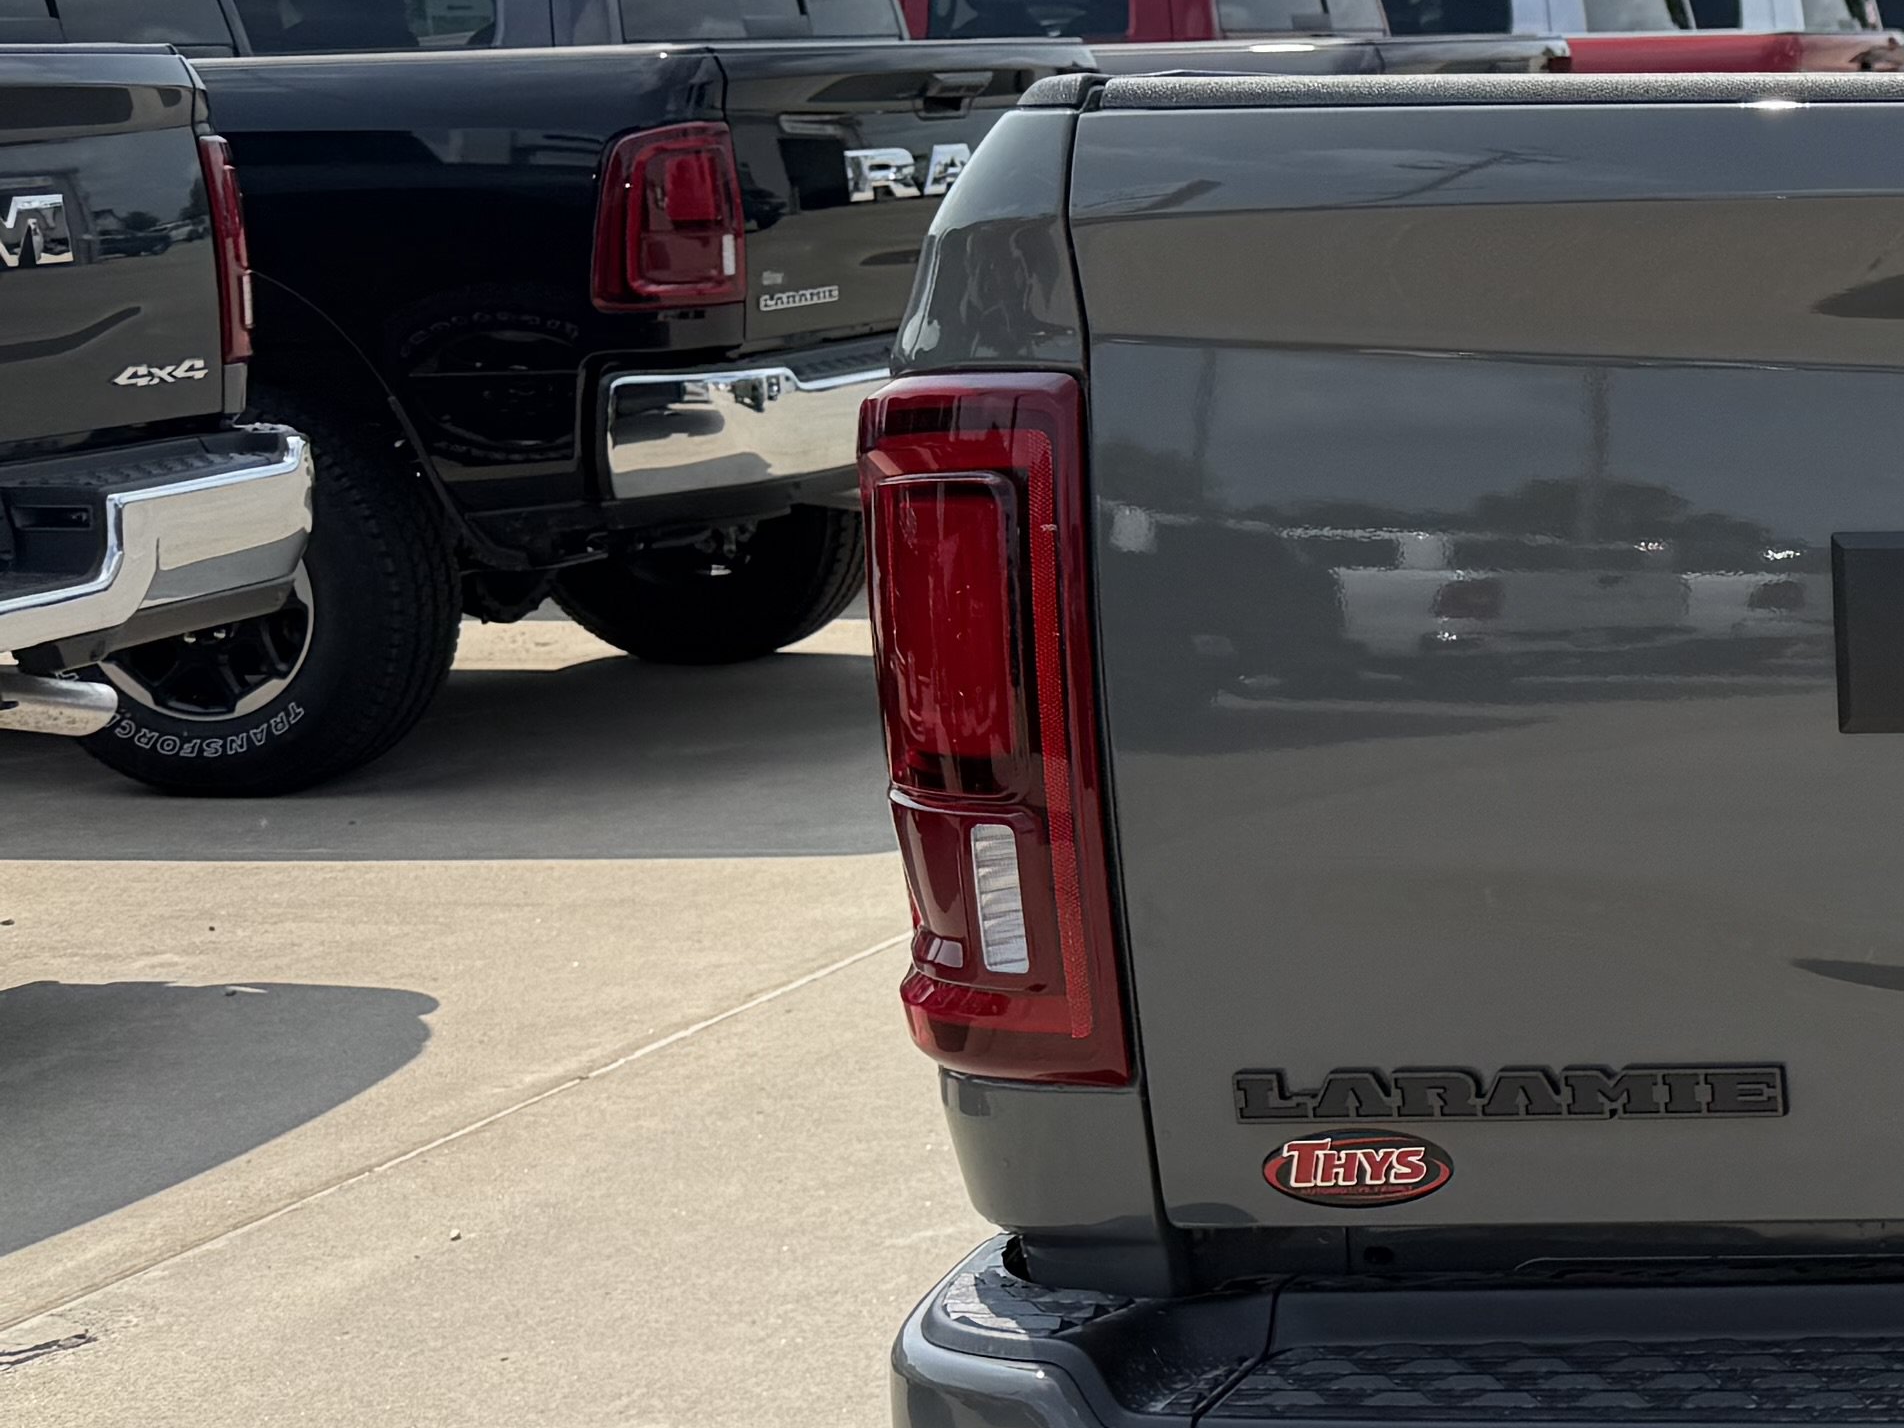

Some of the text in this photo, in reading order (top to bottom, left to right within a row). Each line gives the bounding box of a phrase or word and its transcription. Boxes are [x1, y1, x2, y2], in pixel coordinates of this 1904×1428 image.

[845, 143, 971, 202] RA
[760, 285, 839, 311] LARAMIE
[113, 358, 208, 387] 4x4
[107, 702, 305, 757] TRANSFORC
[1232, 1061, 1789, 1124] LARAMIE
[1283, 1138, 1427, 1188] THYS
